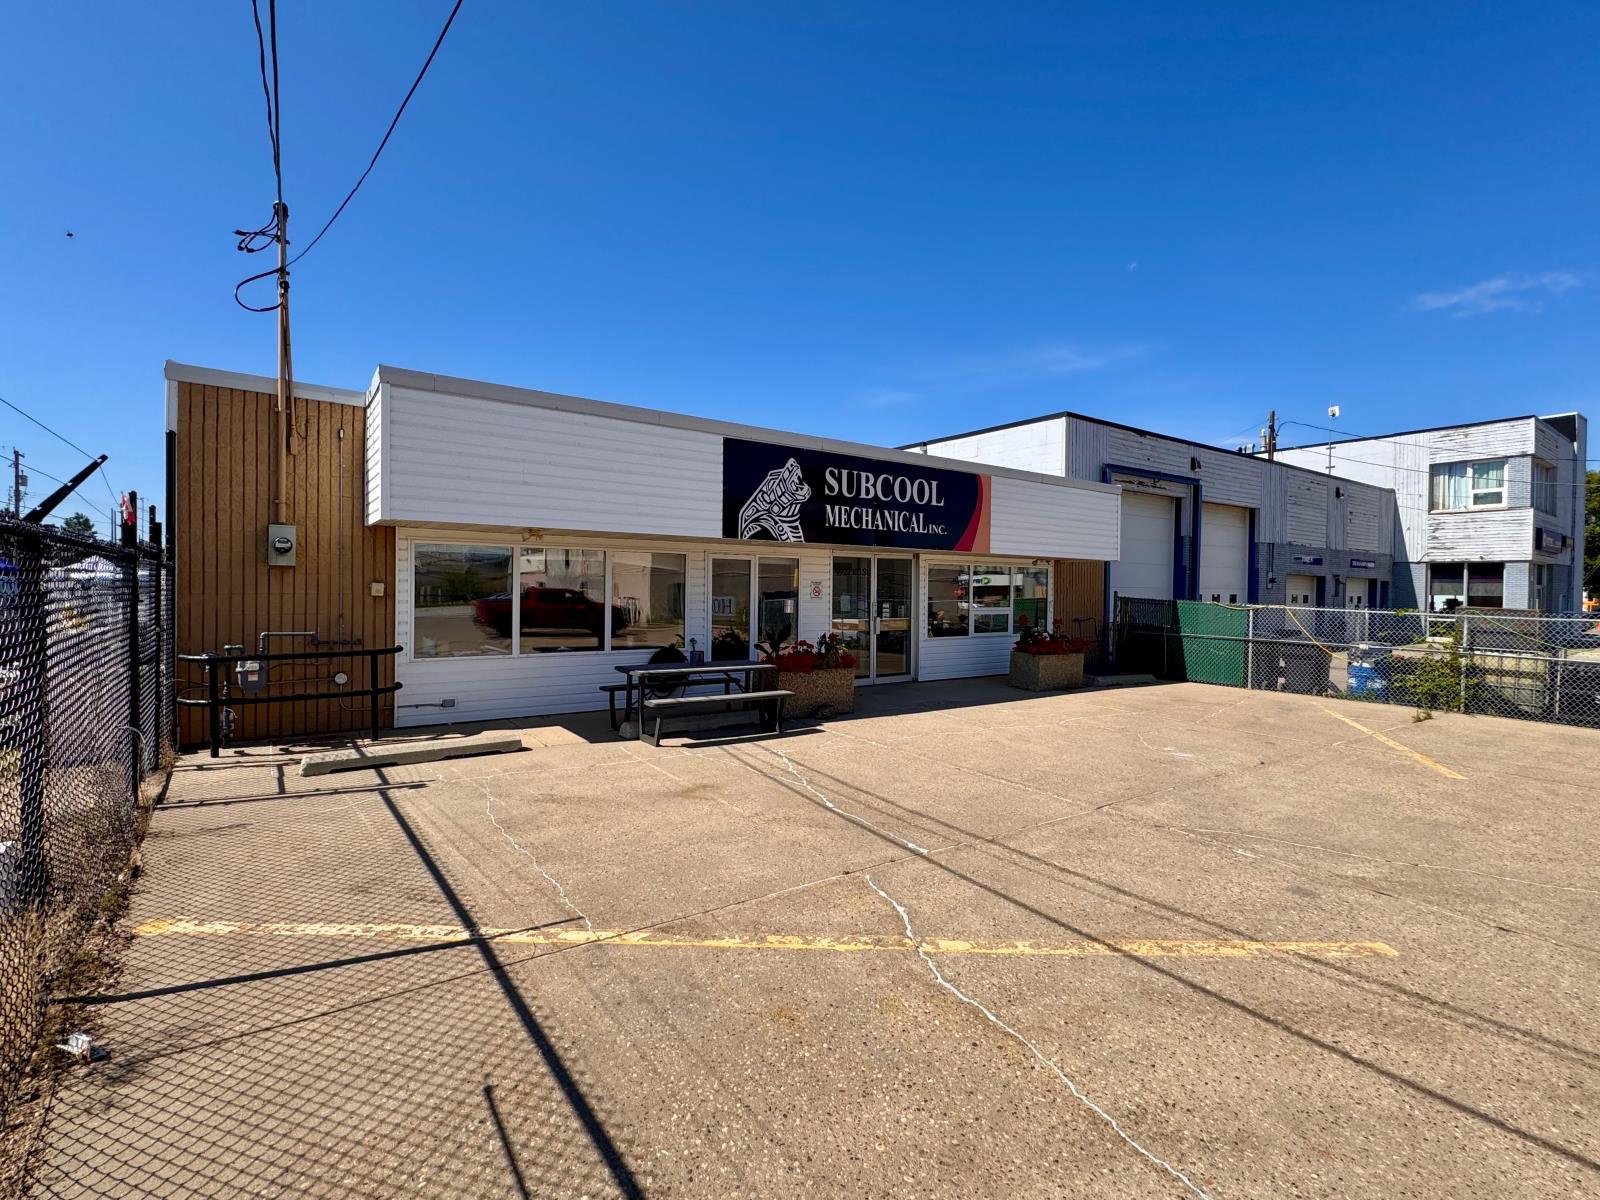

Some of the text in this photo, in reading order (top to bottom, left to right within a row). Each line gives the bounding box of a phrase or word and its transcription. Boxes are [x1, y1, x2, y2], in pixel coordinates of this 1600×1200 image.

[824, 466, 945, 507] SUBCOOL
[824, 504, 948, 535] MECHANICAL INC.
